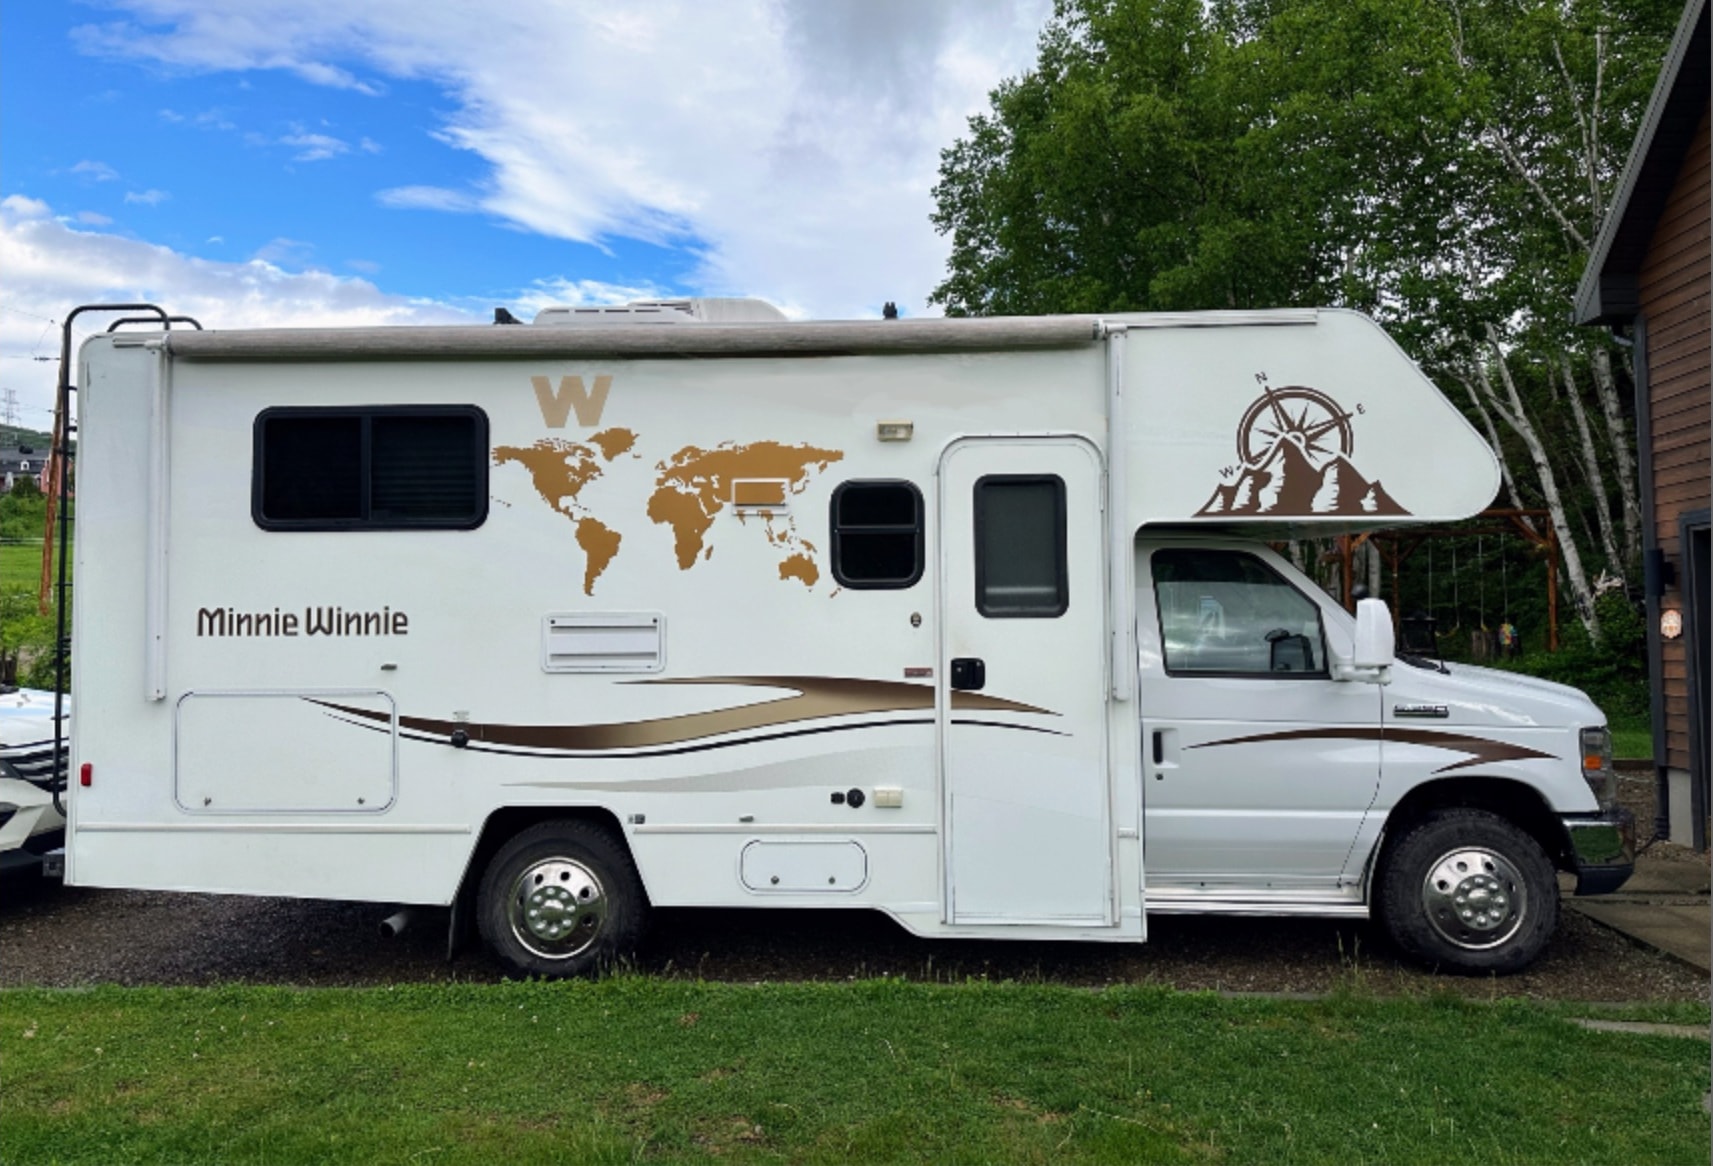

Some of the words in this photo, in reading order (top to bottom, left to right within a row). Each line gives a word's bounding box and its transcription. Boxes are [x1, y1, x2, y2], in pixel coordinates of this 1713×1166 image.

[1254, 371, 1268, 385] N
[531, 376, 613, 428] W
[1218, 465, 1234, 479] W
[196, 607, 299, 637] Minnie
[305, 605, 409, 637] Winnie
